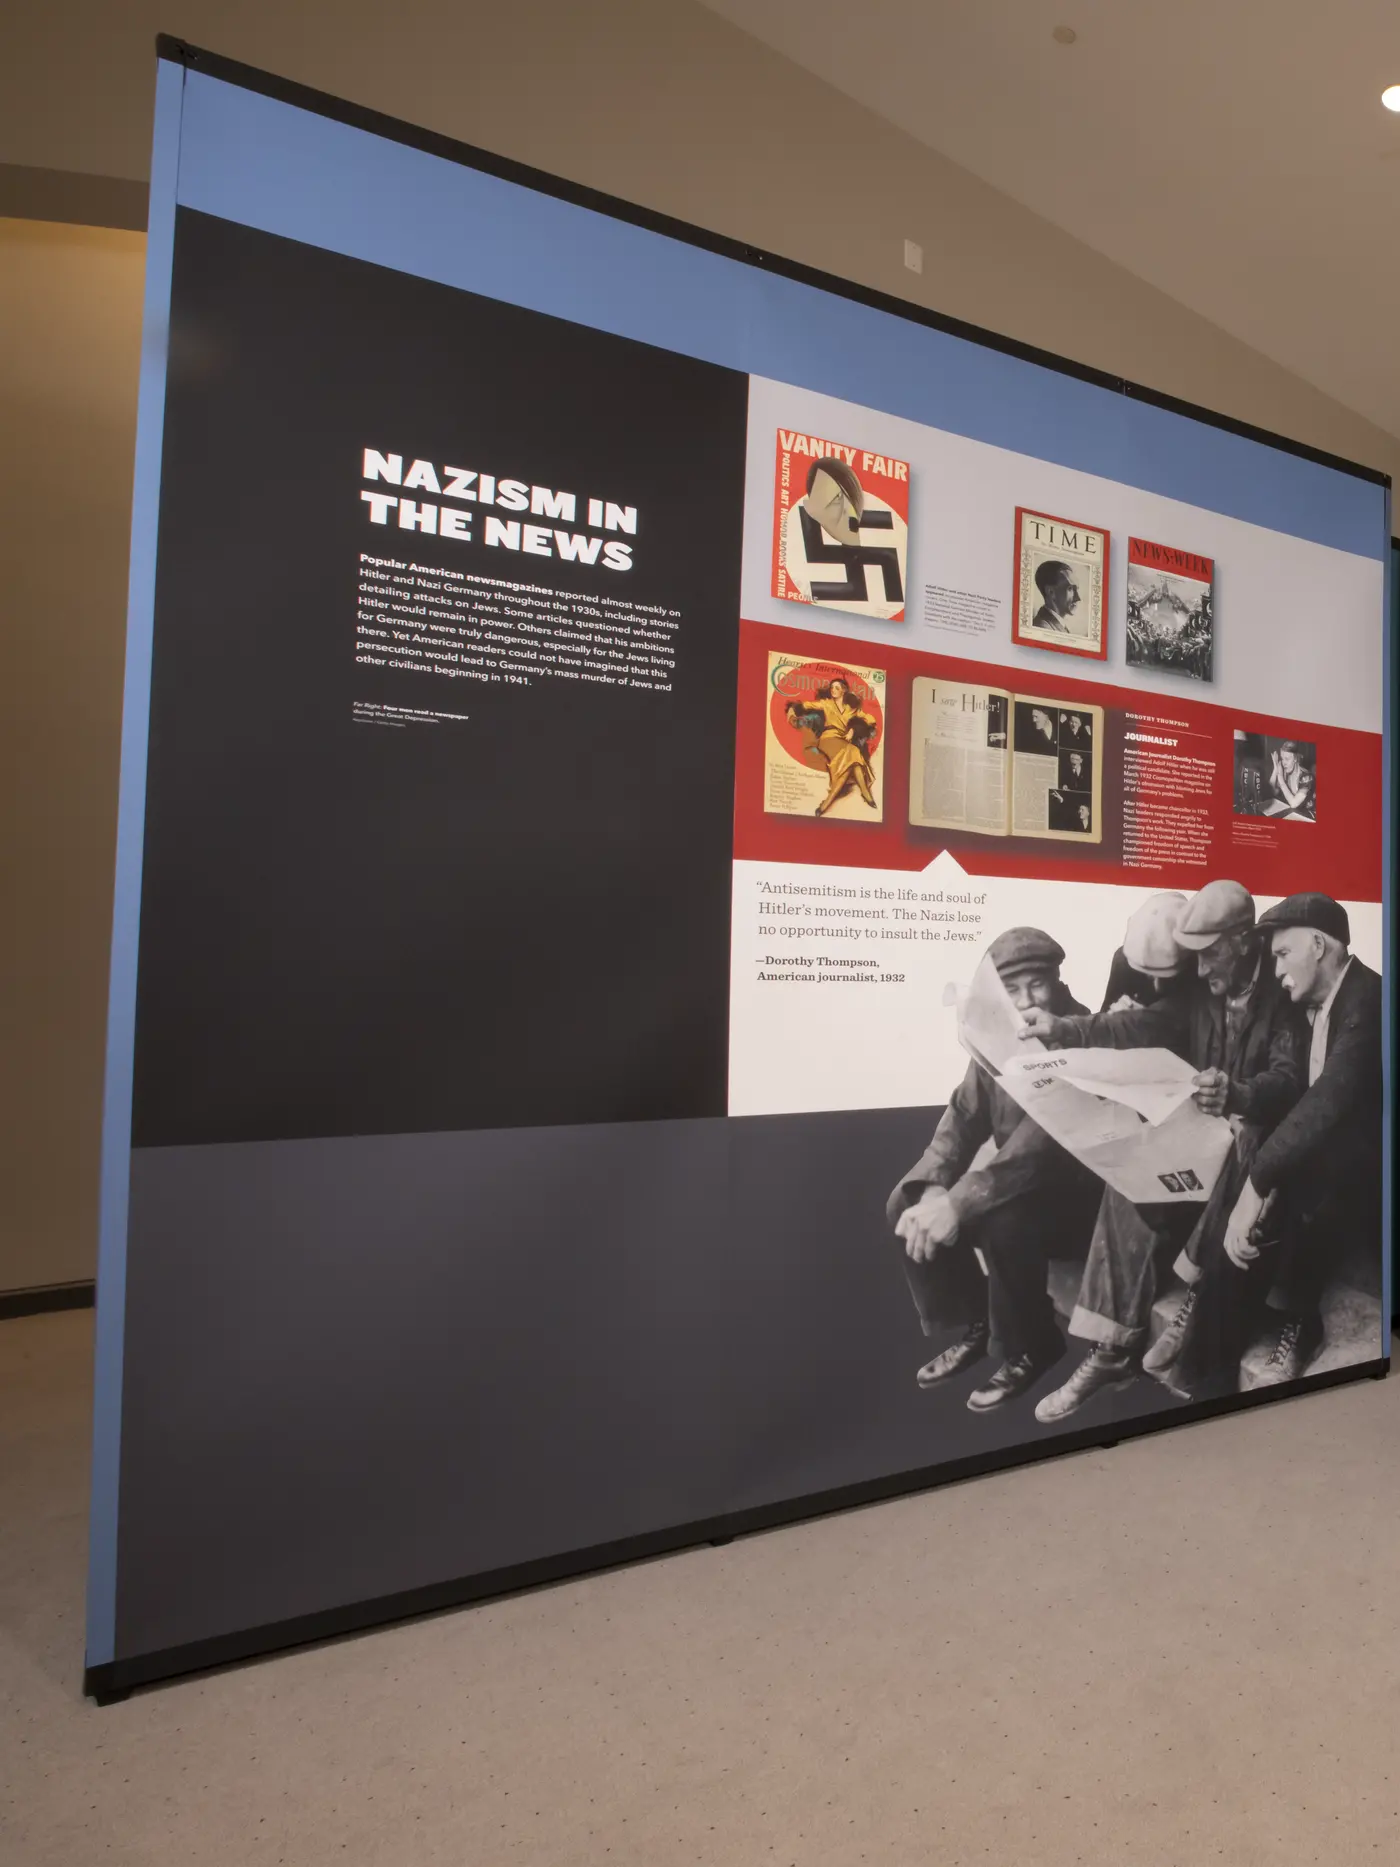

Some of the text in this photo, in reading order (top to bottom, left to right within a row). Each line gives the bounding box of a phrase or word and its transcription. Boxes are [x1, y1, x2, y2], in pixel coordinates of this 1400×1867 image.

[779, 430, 908, 481] VANITY FAIR
[363, 447, 637, 535] NAZISM IN
[360, 490, 633, 571] THE NEWS
[1030, 520, 1096, 554] TIME
[359, 553, 407, 569] Popular
[408, 562, 464, 580] American
[466, 574, 553, 595] newsmagazines
[554, 590, 599, 603] reported
[600, 597, 633, 609] almost
[634, 604, 667, 616] weekly
[359, 567, 679, 629] Hitler and Nazi Germany throughout the 1930s, including stories
[932, 689, 936, 703] I
[962, 694, 1000, 712] Hitler!
[1125, 713, 1190, 728] DOROTHY THOMPSON
[1124, 732, 1178, 747] JOURNALIST
[756, 881, 987, 904] “Antisemitism is the life and soul of
[758, 901, 981, 923] Hitler’s movement. The Nazis lose
[758, 925, 981, 941] no opportunity to insult the Jews.”
[755, 955, 879, 968] —Dorothy Thompson,
[756, 971, 905, 983] American journalist, 1932
[1023, 1059, 1067, 1071] SPORTS
